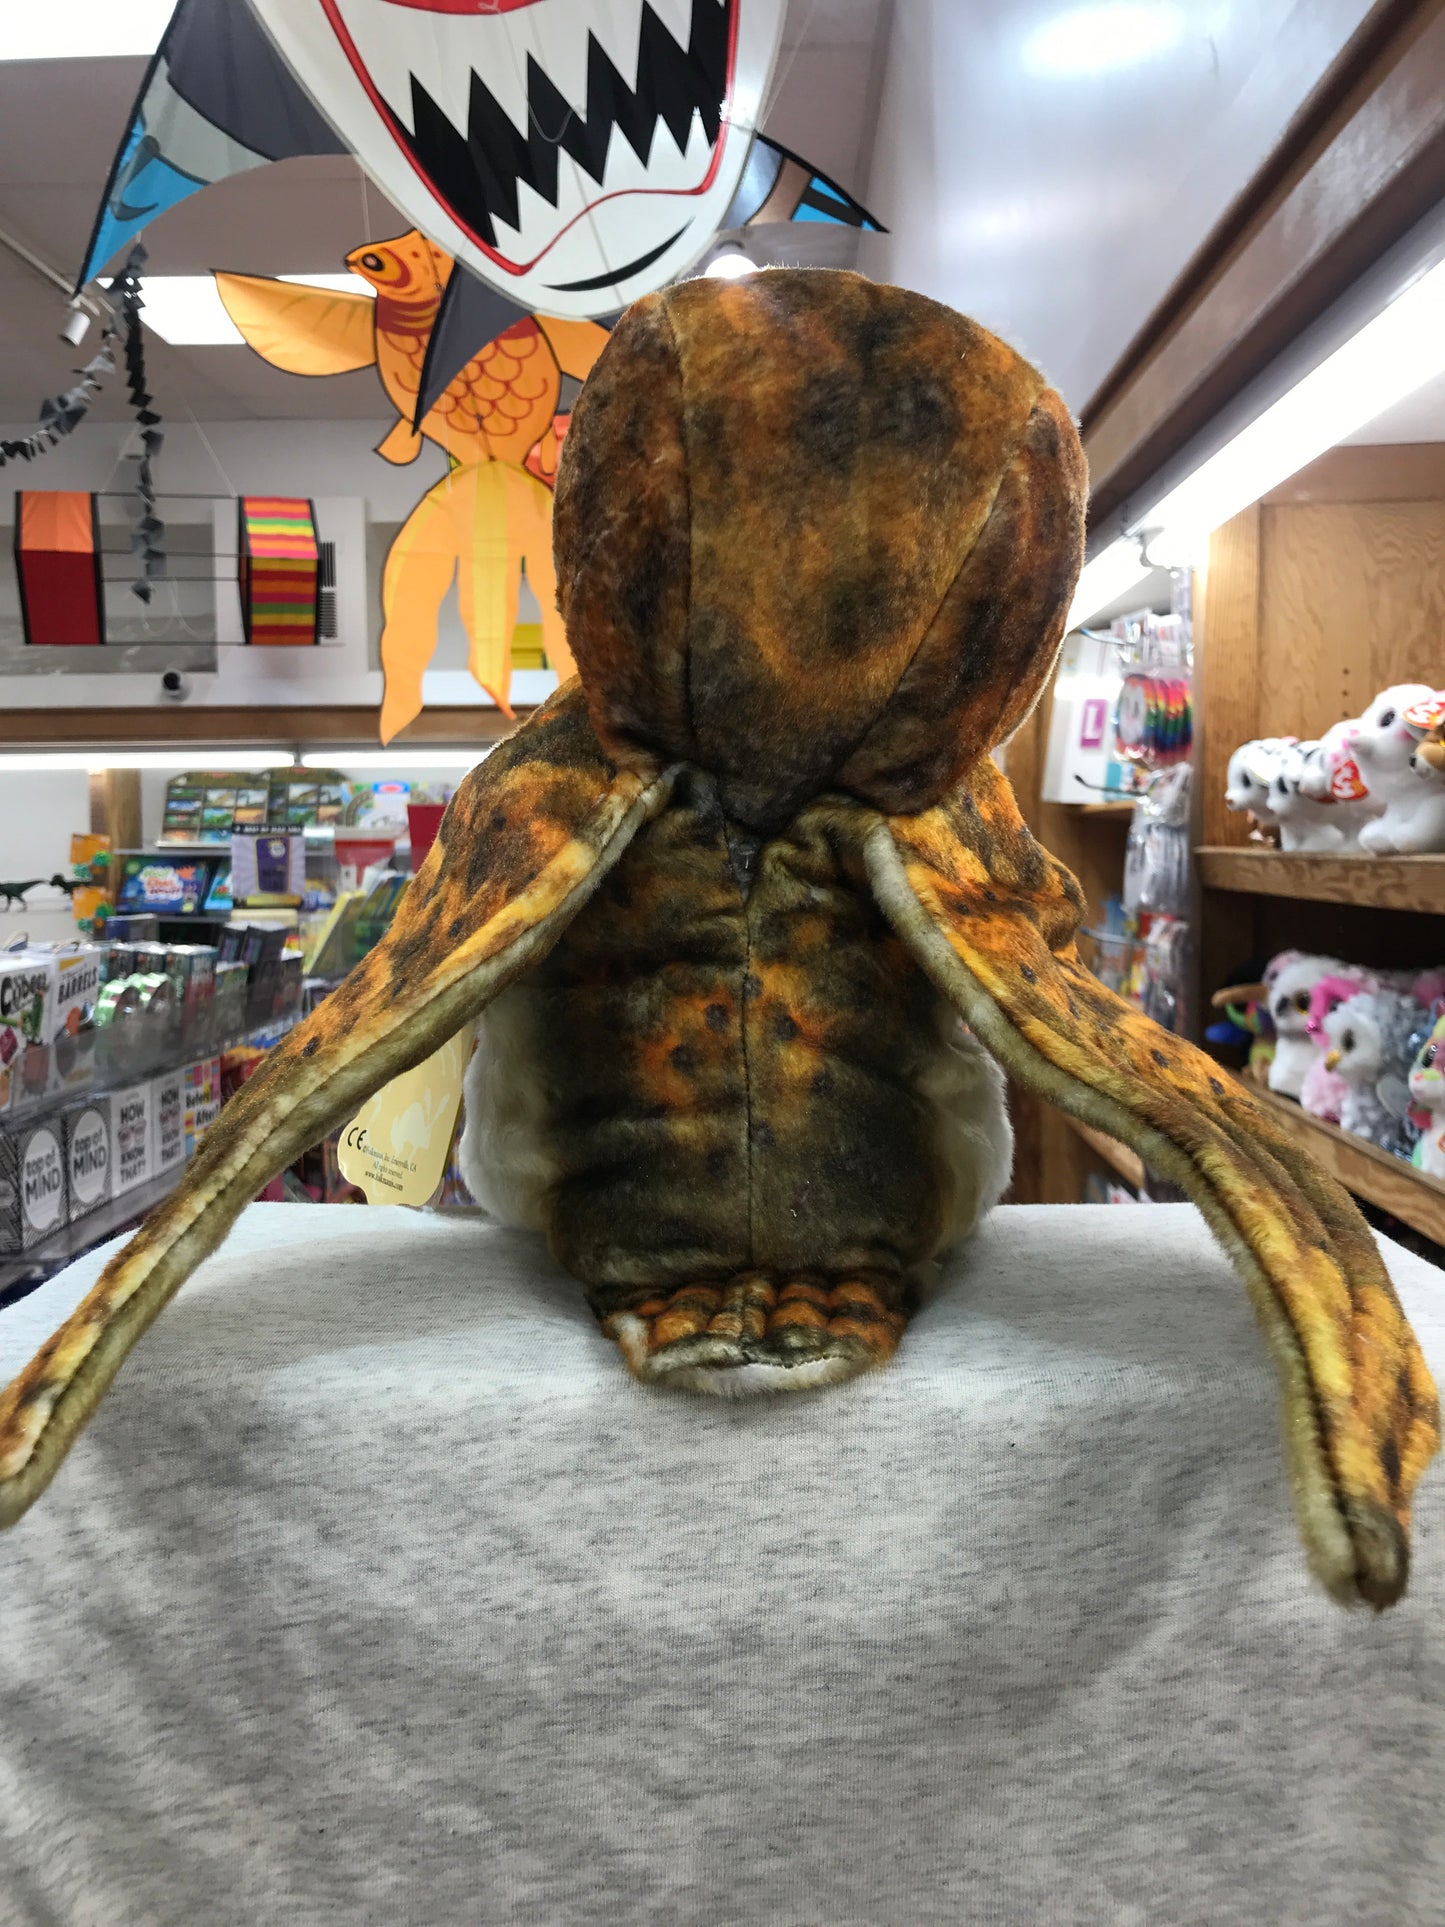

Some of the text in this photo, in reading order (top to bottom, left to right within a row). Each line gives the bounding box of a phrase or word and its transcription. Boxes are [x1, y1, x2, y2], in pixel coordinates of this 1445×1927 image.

[120, 1100, 145, 1123] HOW
[161, 1086, 180, 1106] HOW
[74, 1135, 92, 1155] top
[92, 1127, 103, 1146] of
[26, 1144, 56, 1178] top of
[73, 1145, 107, 1179] MIND
[25, 1167, 60, 1205] MIND
